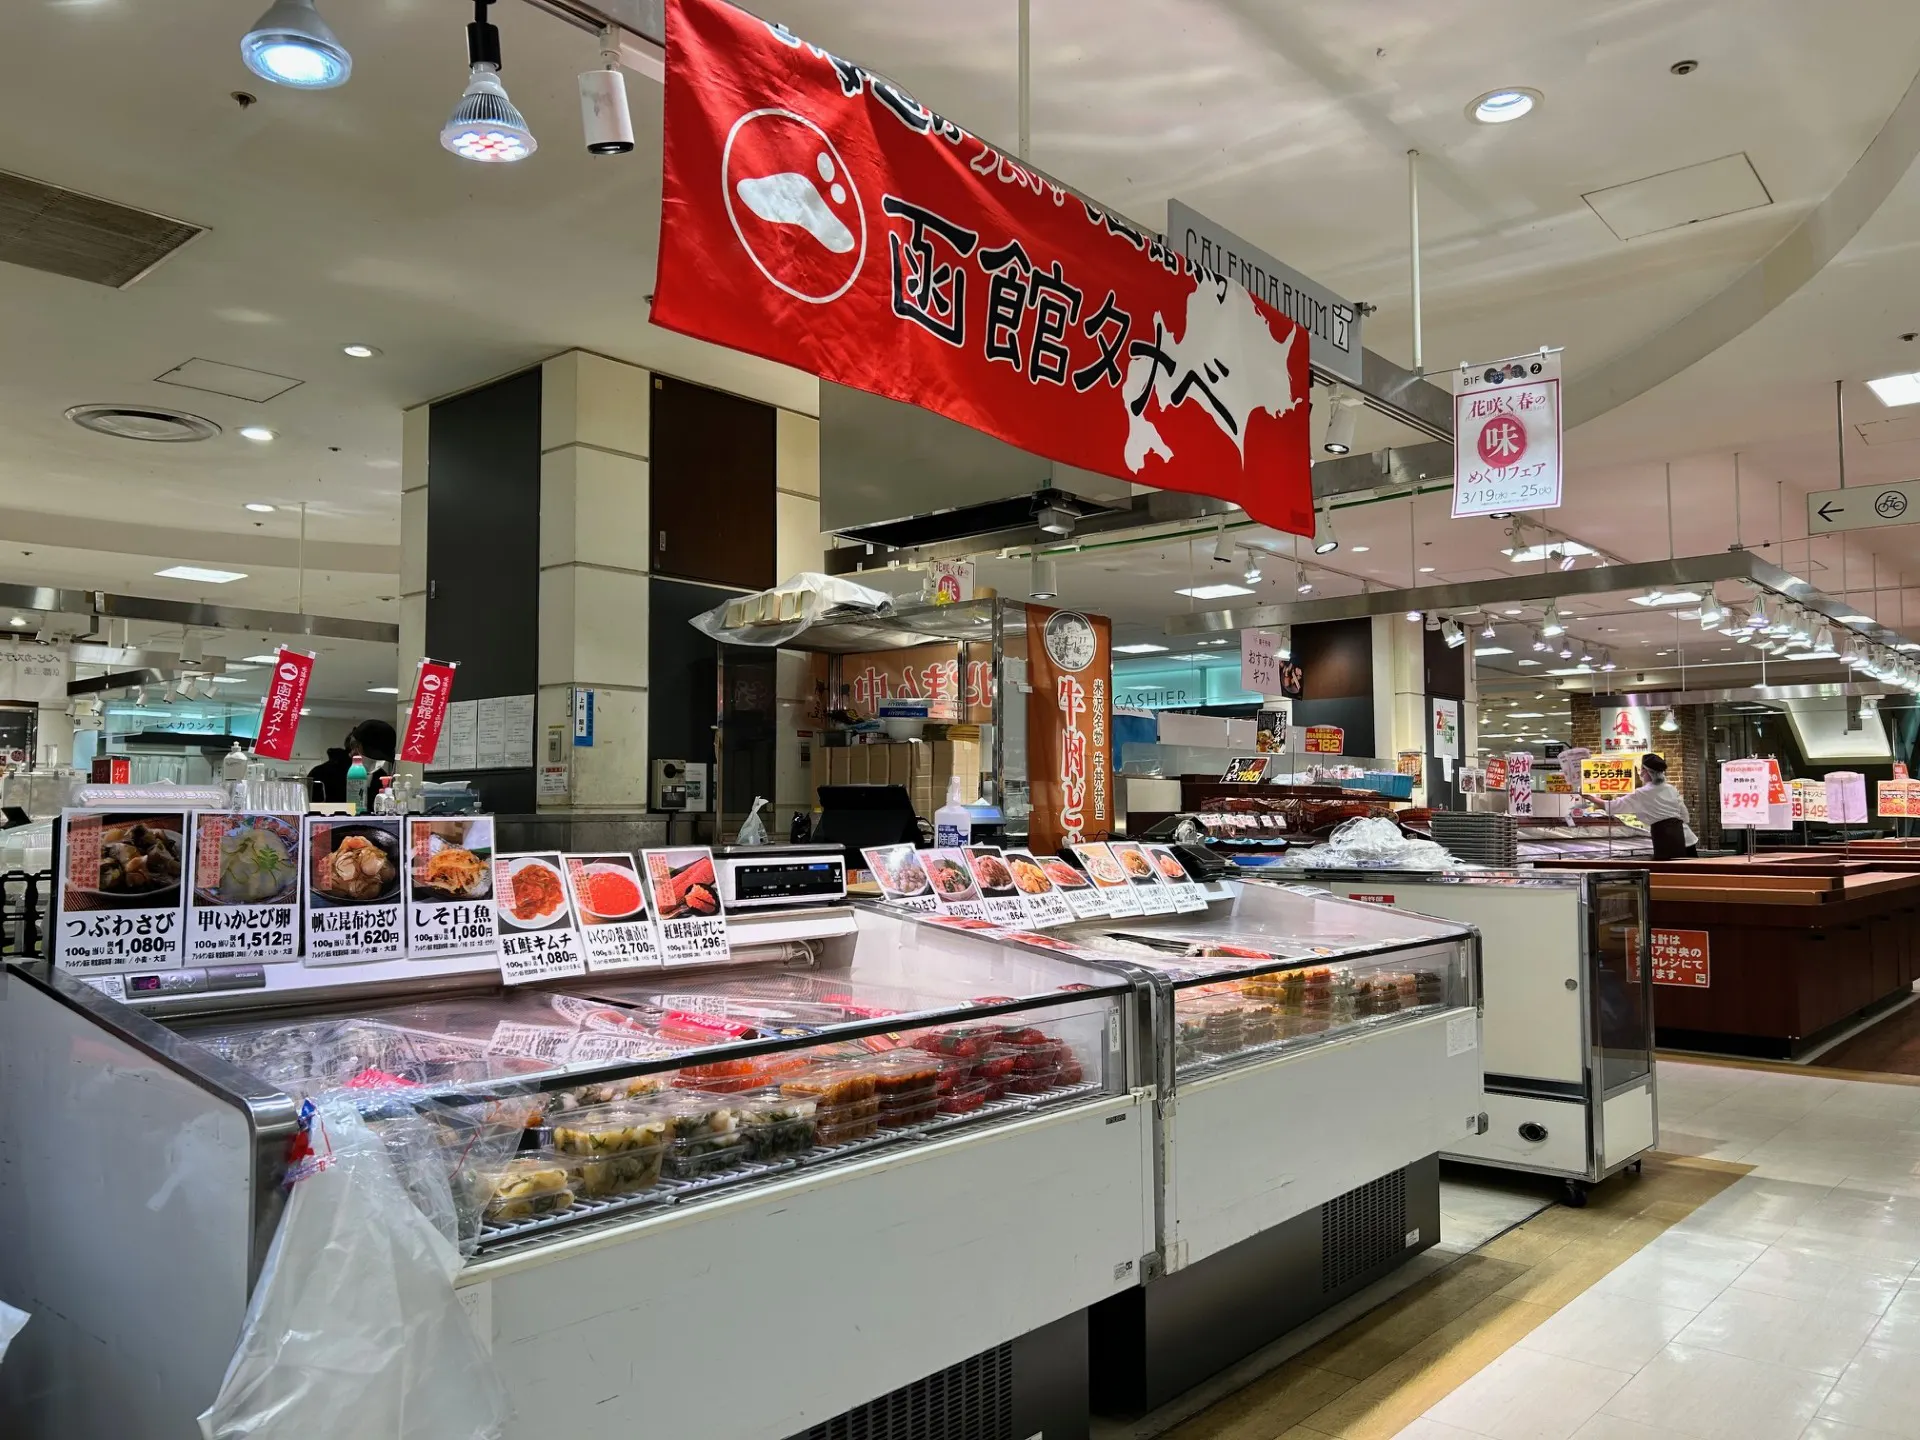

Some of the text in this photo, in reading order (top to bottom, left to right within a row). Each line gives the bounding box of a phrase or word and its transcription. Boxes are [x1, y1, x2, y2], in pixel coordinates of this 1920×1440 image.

[881, 193, 1239, 437] 函館タナベ
[1470, 392, 1546, 418] 花咲く春の
[1485, 424, 1519, 457] 味
[1468, 462, 1546, 483] めぐりフェア
[1114, 690, 1187, 708] CASHIER
[263, 681, 293, 750] 函館タナベ
[408, 692, 436, 755] 函館タナベ
[1584, 769, 1632, 779] 春うらら弁当
[66, 911, 176, 938] つぶわさび
[198, 907, 291, 931] 甲いかとび卵
[311, 907, 397, 933] 帆立昆布わさび
[415, 904, 492, 927] しそ白魚
[194, 940, 216, 948] 100g
[237, 931, 292, 950] 1,512円
[313, 940, 333, 948] 100g
[352, 929, 399, 948] 1,620円
[414, 934, 433, 942] 100g
[450, 924, 493, 942] 1,080円
[502, 932, 572, 955] 紅鮭キムチ
[65, 947, 90, 956] 100g
[115, 937, 176, 957] 1,080円
